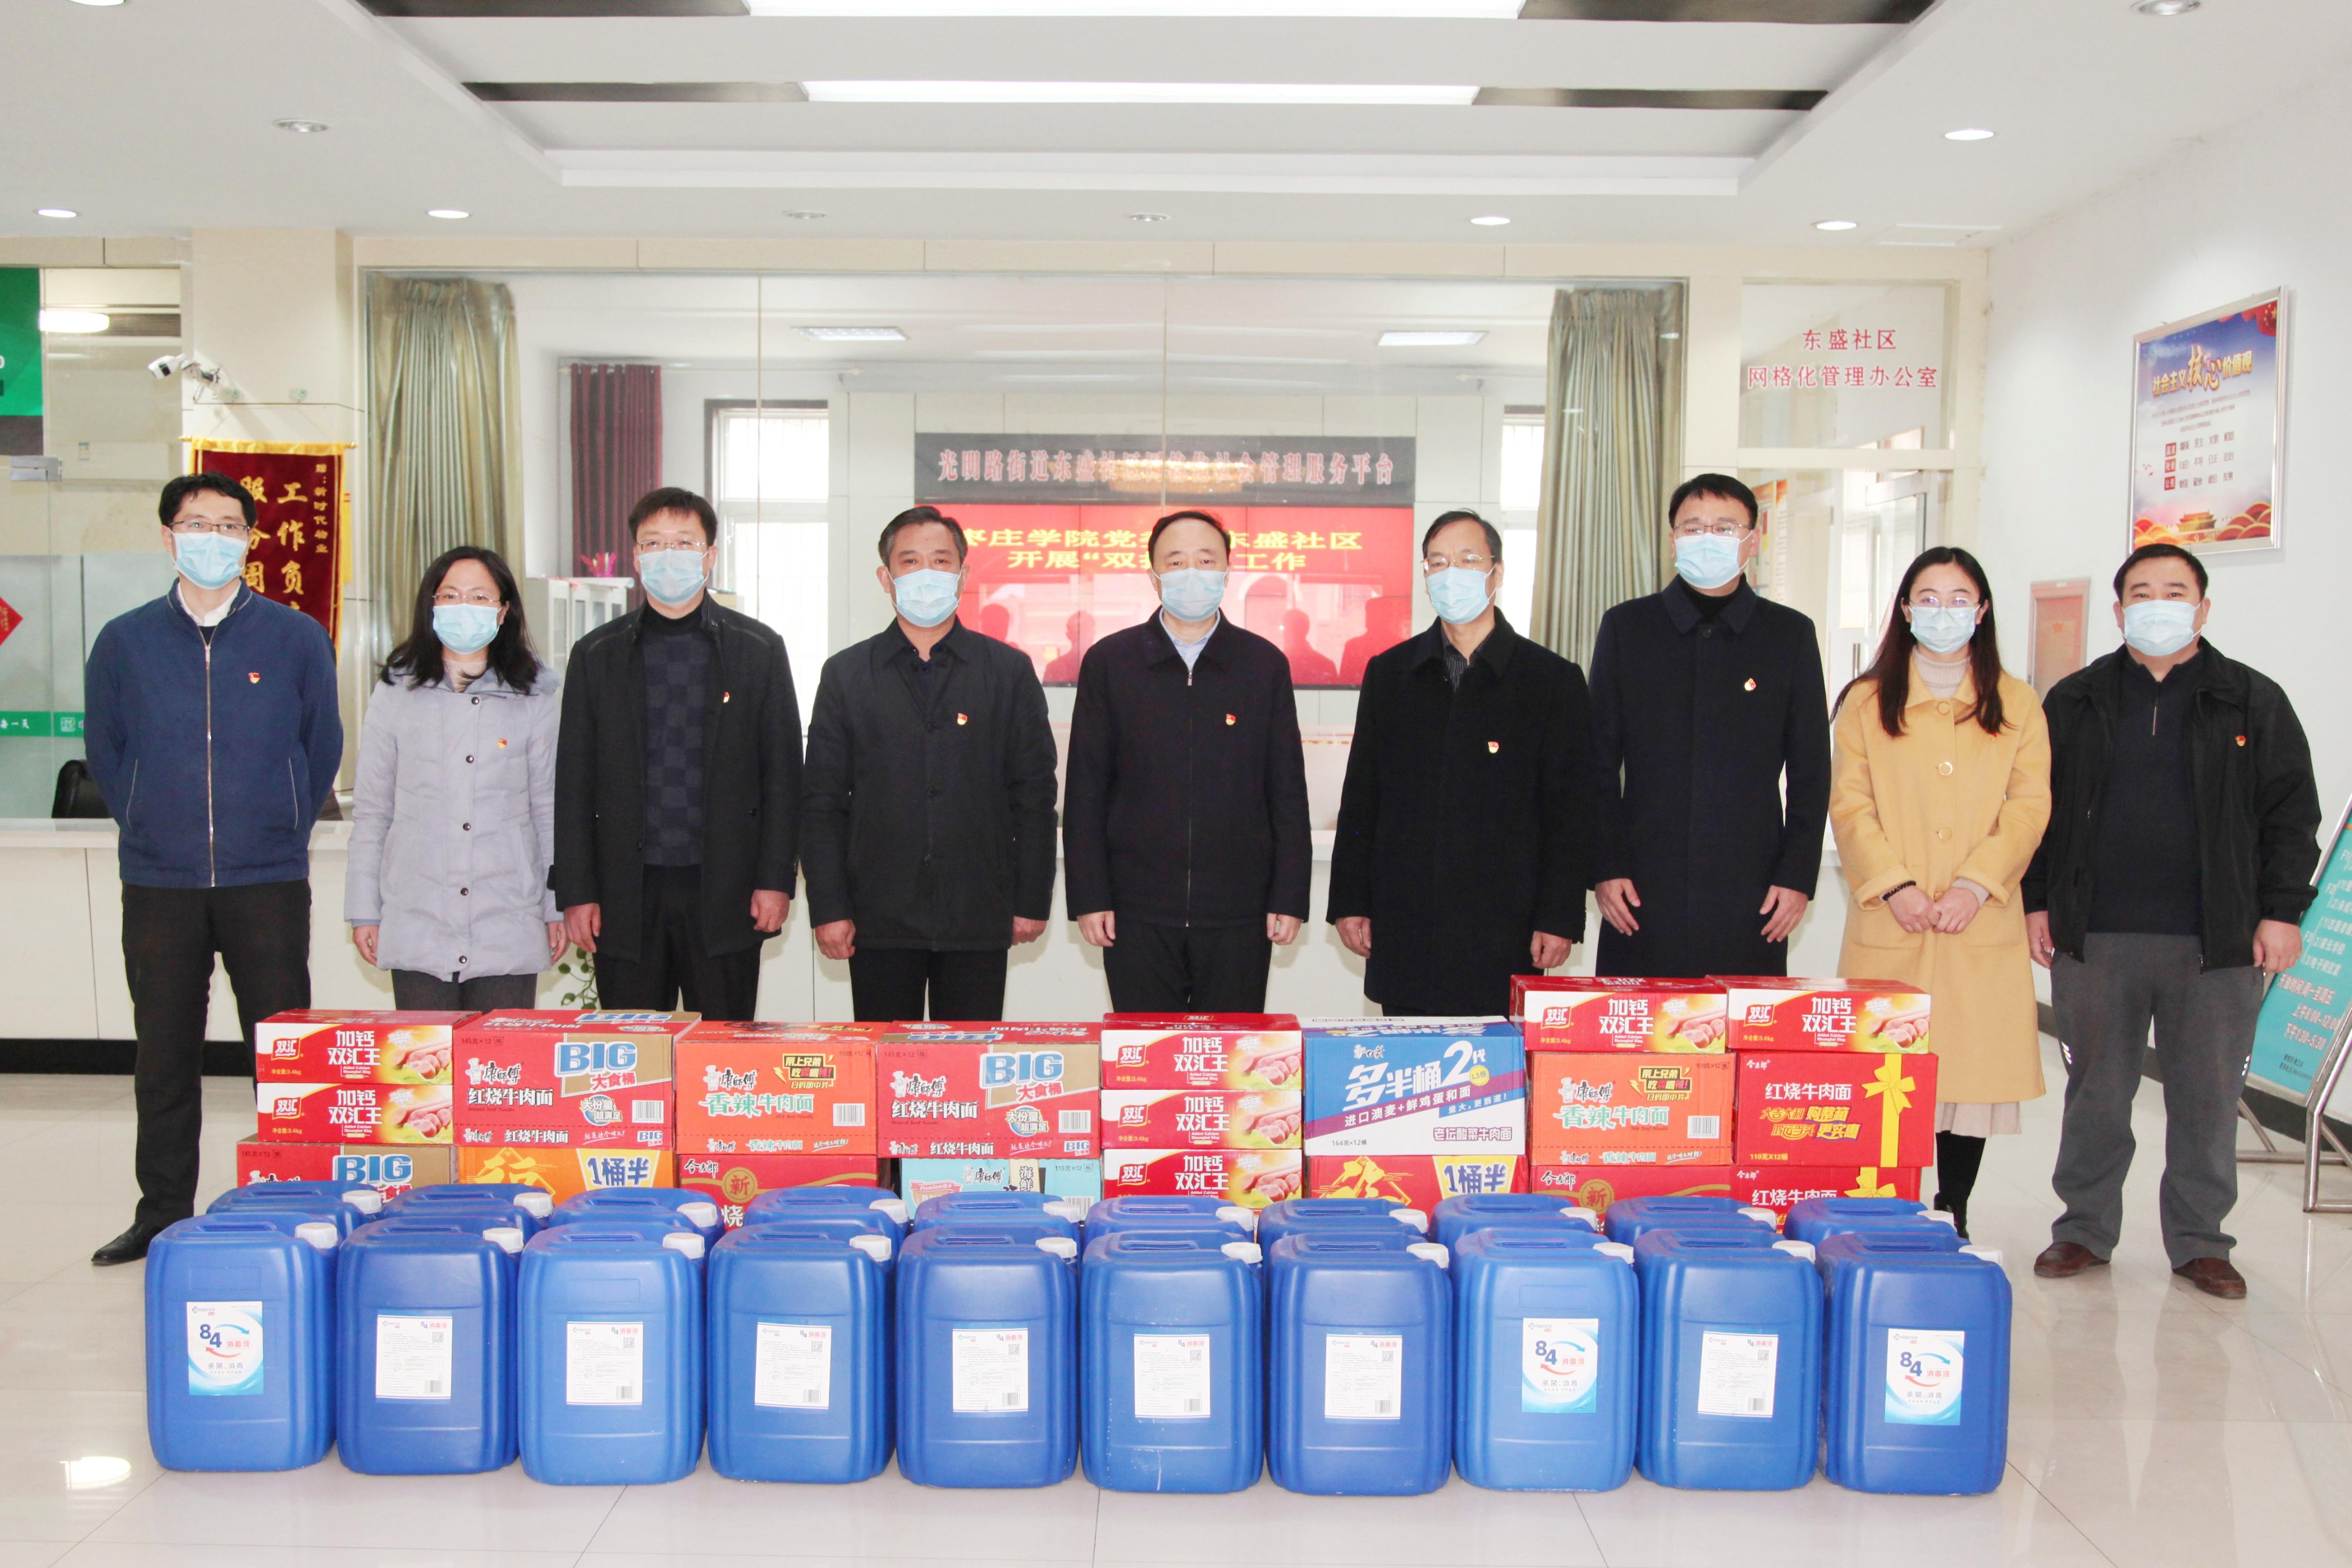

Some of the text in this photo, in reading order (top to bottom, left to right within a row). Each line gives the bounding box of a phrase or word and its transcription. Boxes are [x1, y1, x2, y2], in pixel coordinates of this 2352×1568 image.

[1802, 329, 1897, 350] 东盛社区
[1748, 366, 1938, 388] 网格化管理办公室
[2152, 343, 2252, 397] 社会主义核心价值观
[277, 482, 308, 610] 工作负
[1229, 531, 1362, 550] 东盛社区
[1234, 553, 1306, 571] 工作
[1608, 999, 1648, 1015] 加钙
[1750, 1006, 1771, 1019] 双汇
[1812, 997, 1851, 1014] 加钙
[1547, 1008, 1567, 1022] 双汇
[1802, 1015, 1857, 1033] 双汇王
[1599, 1017, 1654, 1035] 双汇王
[275, 1040, 296, 1053] 双汇
[336, 1030, 374, 1047] 加钙
[1183, 1037, 1222, 1053] 加钙
[327, 1047, 381, 1065] 双汇王
[559, 1044, 636, 1072] BIG
[785, 1056, 821, 1066] 带上兄弟
[1122, 1047, 1142, 1060] 双汇
[985, 1054, 1063, 1084] BIG
[1174, 1054, 1229, 1072] 双汇王
[485, 1062, 521, 1083] 康師傅
[591, 1071, 636, 1091] 大食桶
[721, 1069, 757, 1090] 康師傅
[1642, 1069, 1678, 1078] 带上兄弟
[908, 1076, 946, 1096] 康師傅
[1017, 1083, 1062, 1102] 大食桶
[1576, 1081, 1612, 1102] 康師傅
[1766, 1083, 1851, 1101] 红烧牛肉面
[276, 1099, 297, 1112] 双汇
[337, 1089, 376, 1106] 加钙
[467, 1088, 553, 1106] 红烧牛肉面
[580, 1099, 616, 1111] 大份量
[699, 1093, 814, 1118] 香辣牛肉面
[1185, 1096, 1224, 1113] 加钙
[1344, 1085, 1471, 1127] 进口澳麦+鲜鸡蛋和面
[328, 1107, 383, 1124] 双汇王
[595, 1110, 622, 1122] 超满足
[892, 1101, 978, 1119] 红烧牛肉面
[1006, 1110, 1041, 1122] 大份量
[1123, 1106, 1144, 1120] 双汇
[1553, 1106, 1669, 1130] 香辣牛肉面
[1760, 1106, 1850, 1122] 大吉大利 购整箱
[1021, 1122, 1048, 1133] 超满足
[1176, 1114, 1231, 1131] 双汇王
[504, 1130, 569, 1143] 红烧牛肉面
[638, 1131, 663, 1141] BIG
[1433, 1127, 1512, 1141] 老坛酸菜牛肉面
[1771, 1123, 1861, 1141] 鸿运当头 更实惠
[746, 1140, 803, 1151] 香辣牛肉面
[930, 1142, 994, 1155] 红烧牛肉面
[1065, 1141, 1089, 1150] BIG
[1184, 1155, 1223, 1172] 加钙
[1599, 1151, 1656, 1164] 香辣牛肉面
[334, 1155, 412, 1183] BIG
[587, 1157, 650, 1186] 1桶半
[685, 1159, 718, 1178] 今麦郎
[975, 1168, 1003, 1184] 康師傅
[1123, 1166, 1144, 1179] 双汇
[730, 1176, 749, 1195] 新
[1020, 1166, 1034, 1191] 海鲜
[1175, 1173, 1229, 1190] 双汇王
[1443, 1163, 1507, 1193] 1桶半
[1541, 1171, 1576, 1190] 今麦郎
[1586, 1187, 1607, 1208] 新
[200, 1324, 222, 1348] 84
[1535, 1340, 1557, 1365] 84
[1900, 1352, 1922, 1377] 84
